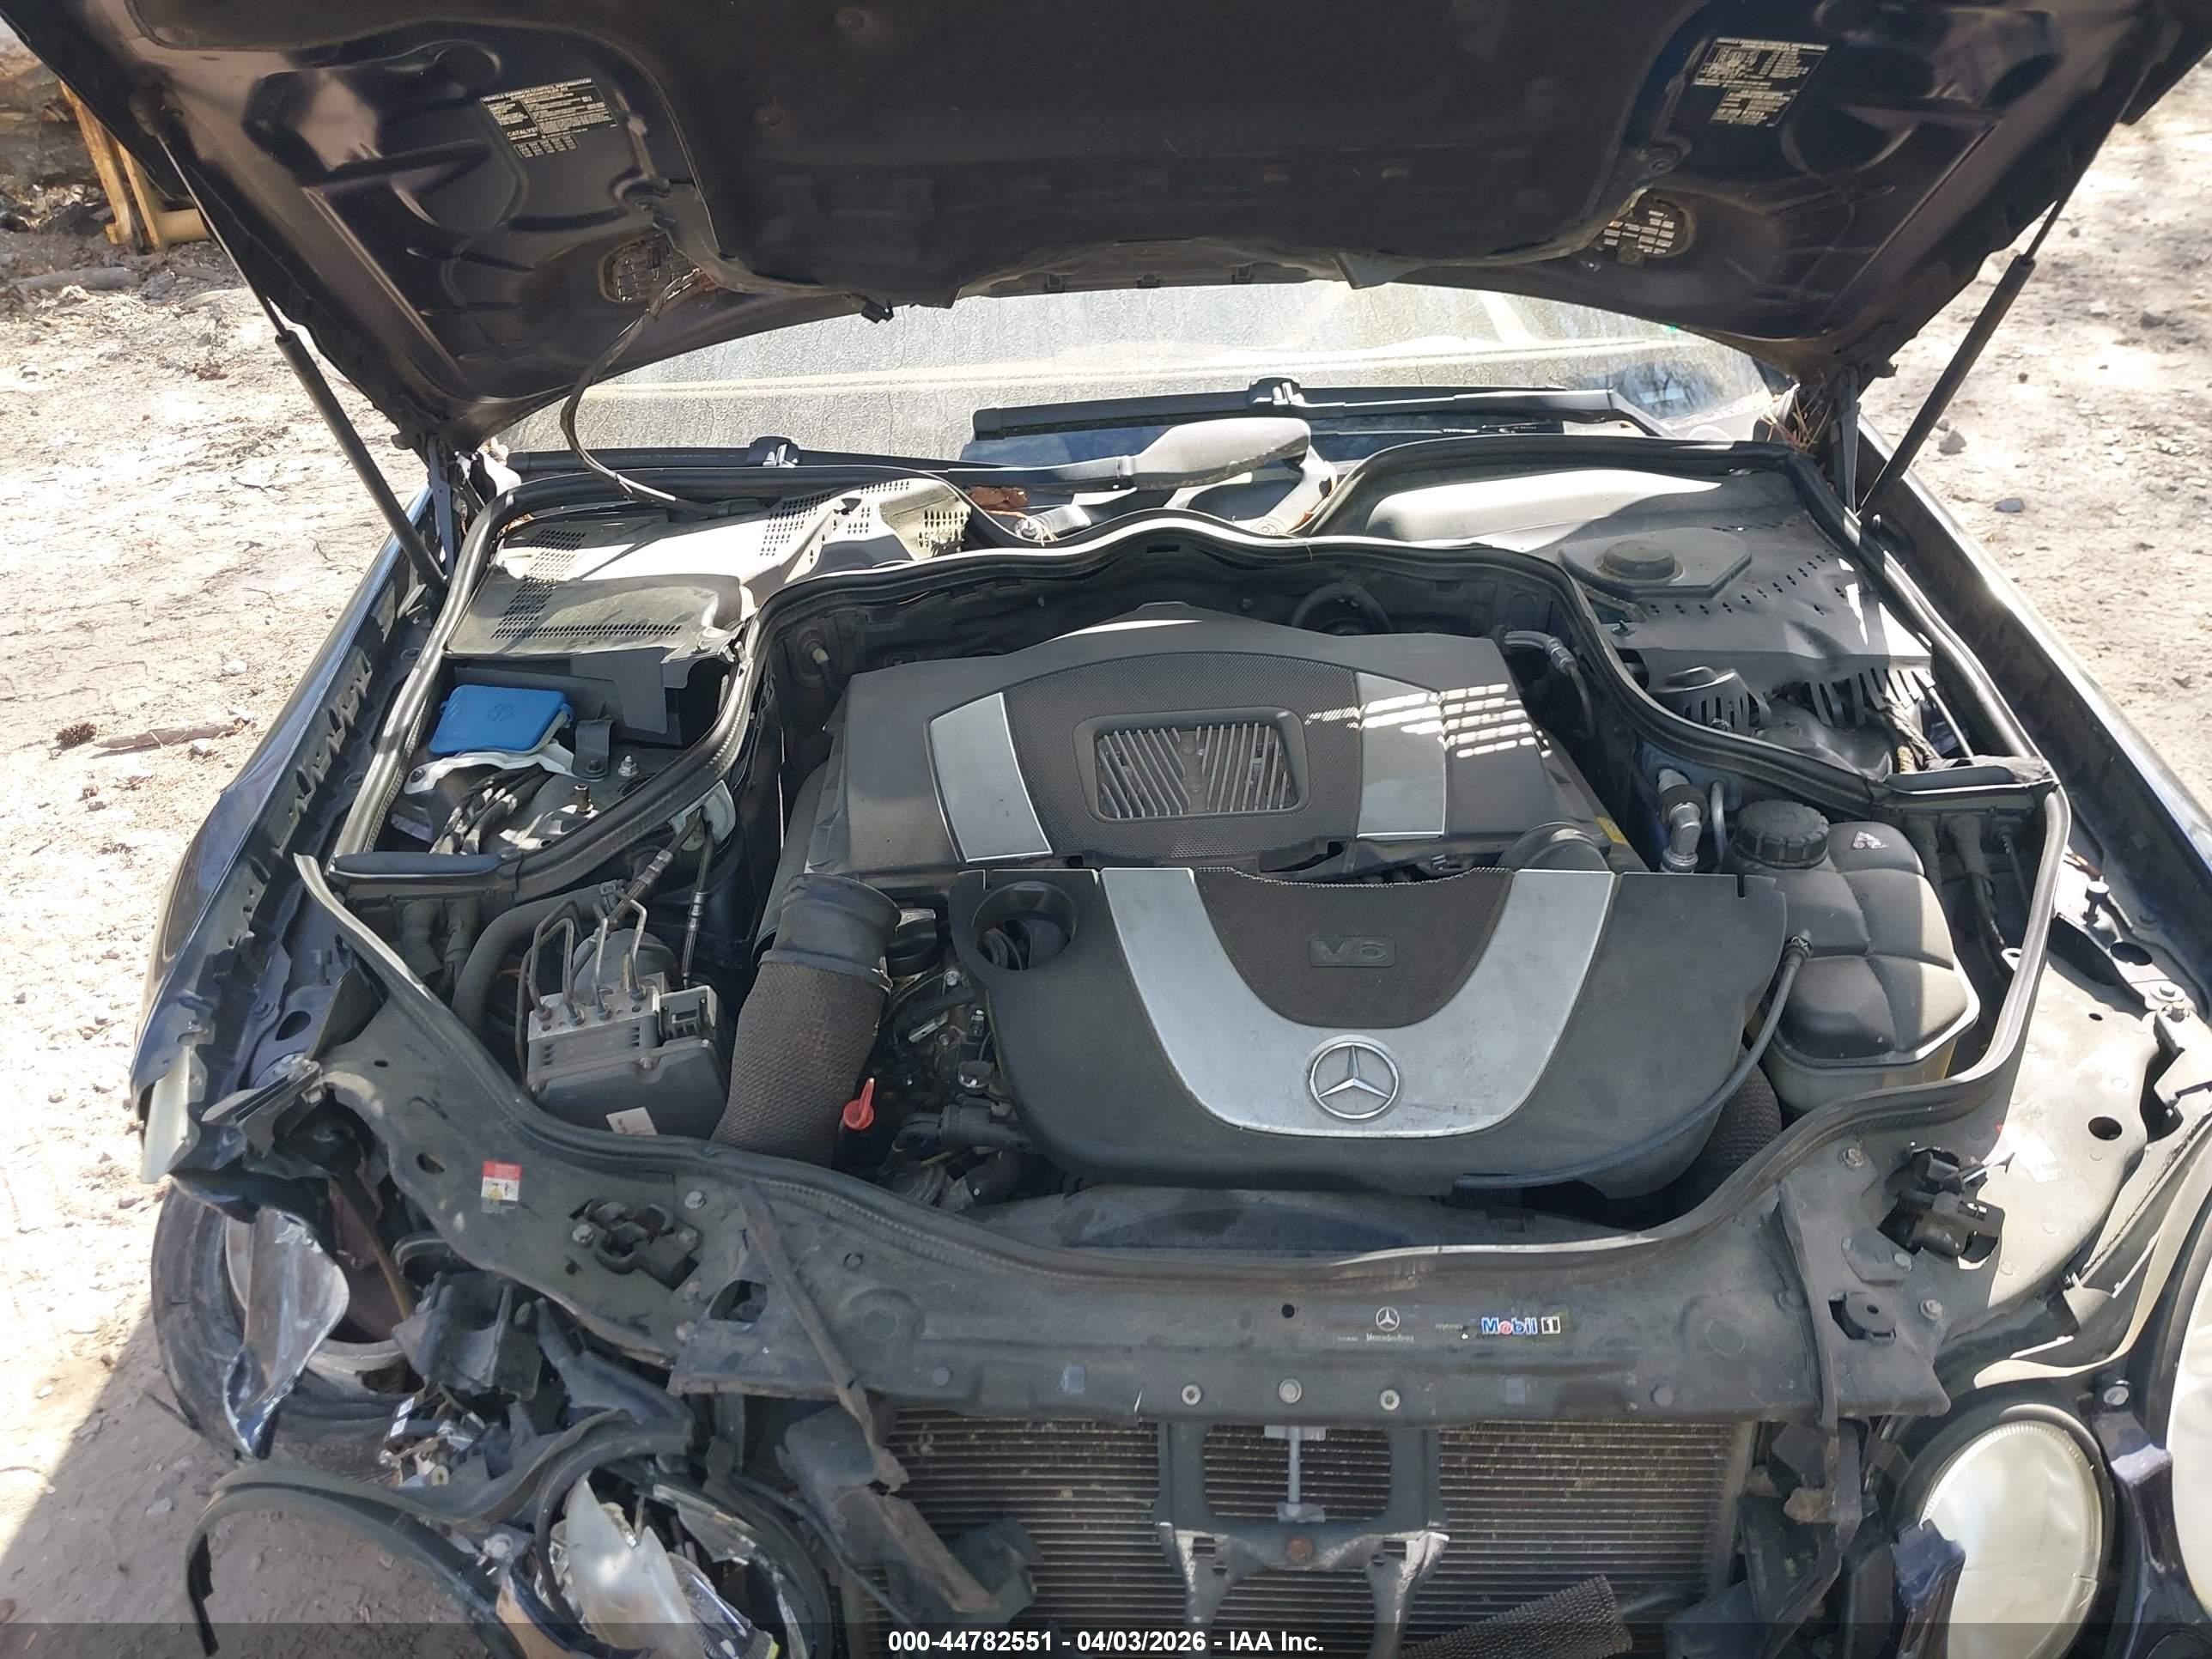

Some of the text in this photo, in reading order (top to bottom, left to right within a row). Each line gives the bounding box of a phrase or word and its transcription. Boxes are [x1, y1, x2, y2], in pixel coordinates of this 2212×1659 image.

[507, 126, 538, 137] CATALYST
[1313, 939, 1387, 962] V6
[1481, 1316, 1537, 1334] Mobil
